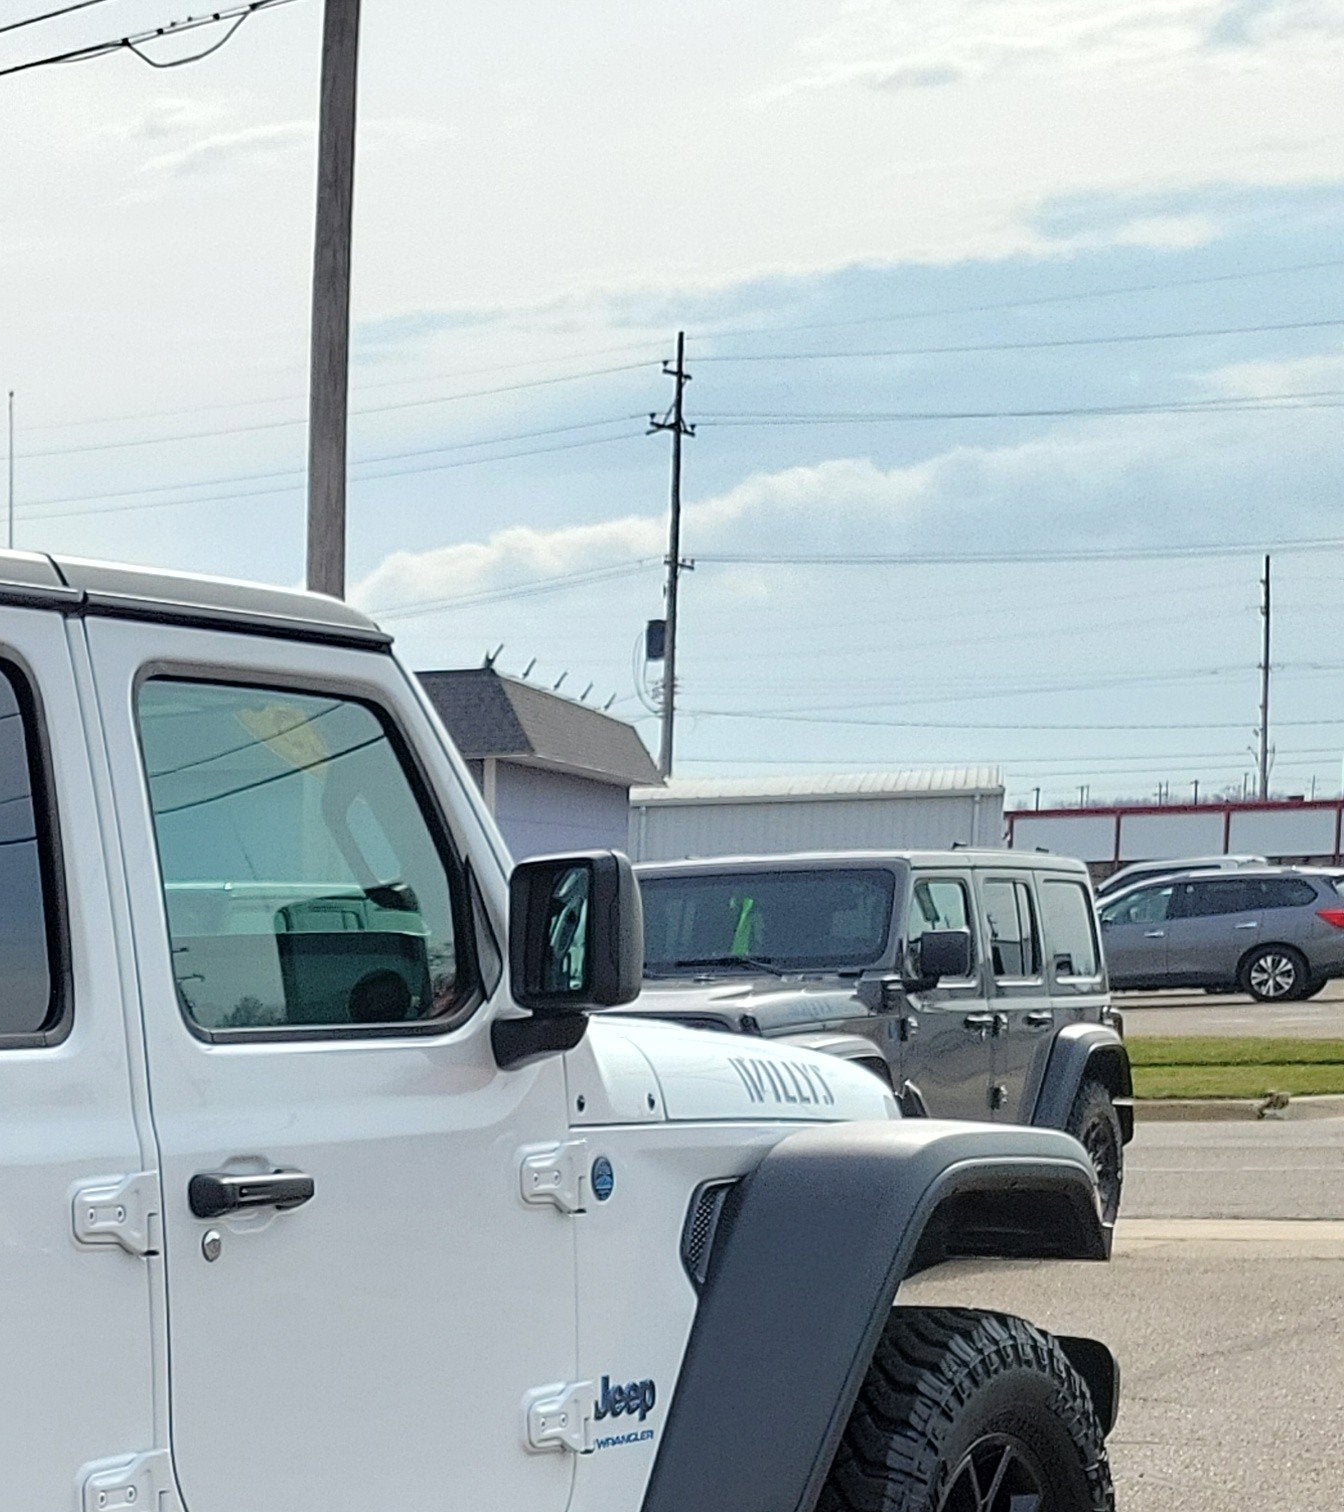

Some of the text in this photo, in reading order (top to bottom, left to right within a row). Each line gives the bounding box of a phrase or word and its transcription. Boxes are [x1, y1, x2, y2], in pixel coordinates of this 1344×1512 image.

[727, 1056, 835, 1106] WILLYS
[593, 1373, 656, 1422] Jeep
[595, 1429, 654, 1450] WRANGLER
